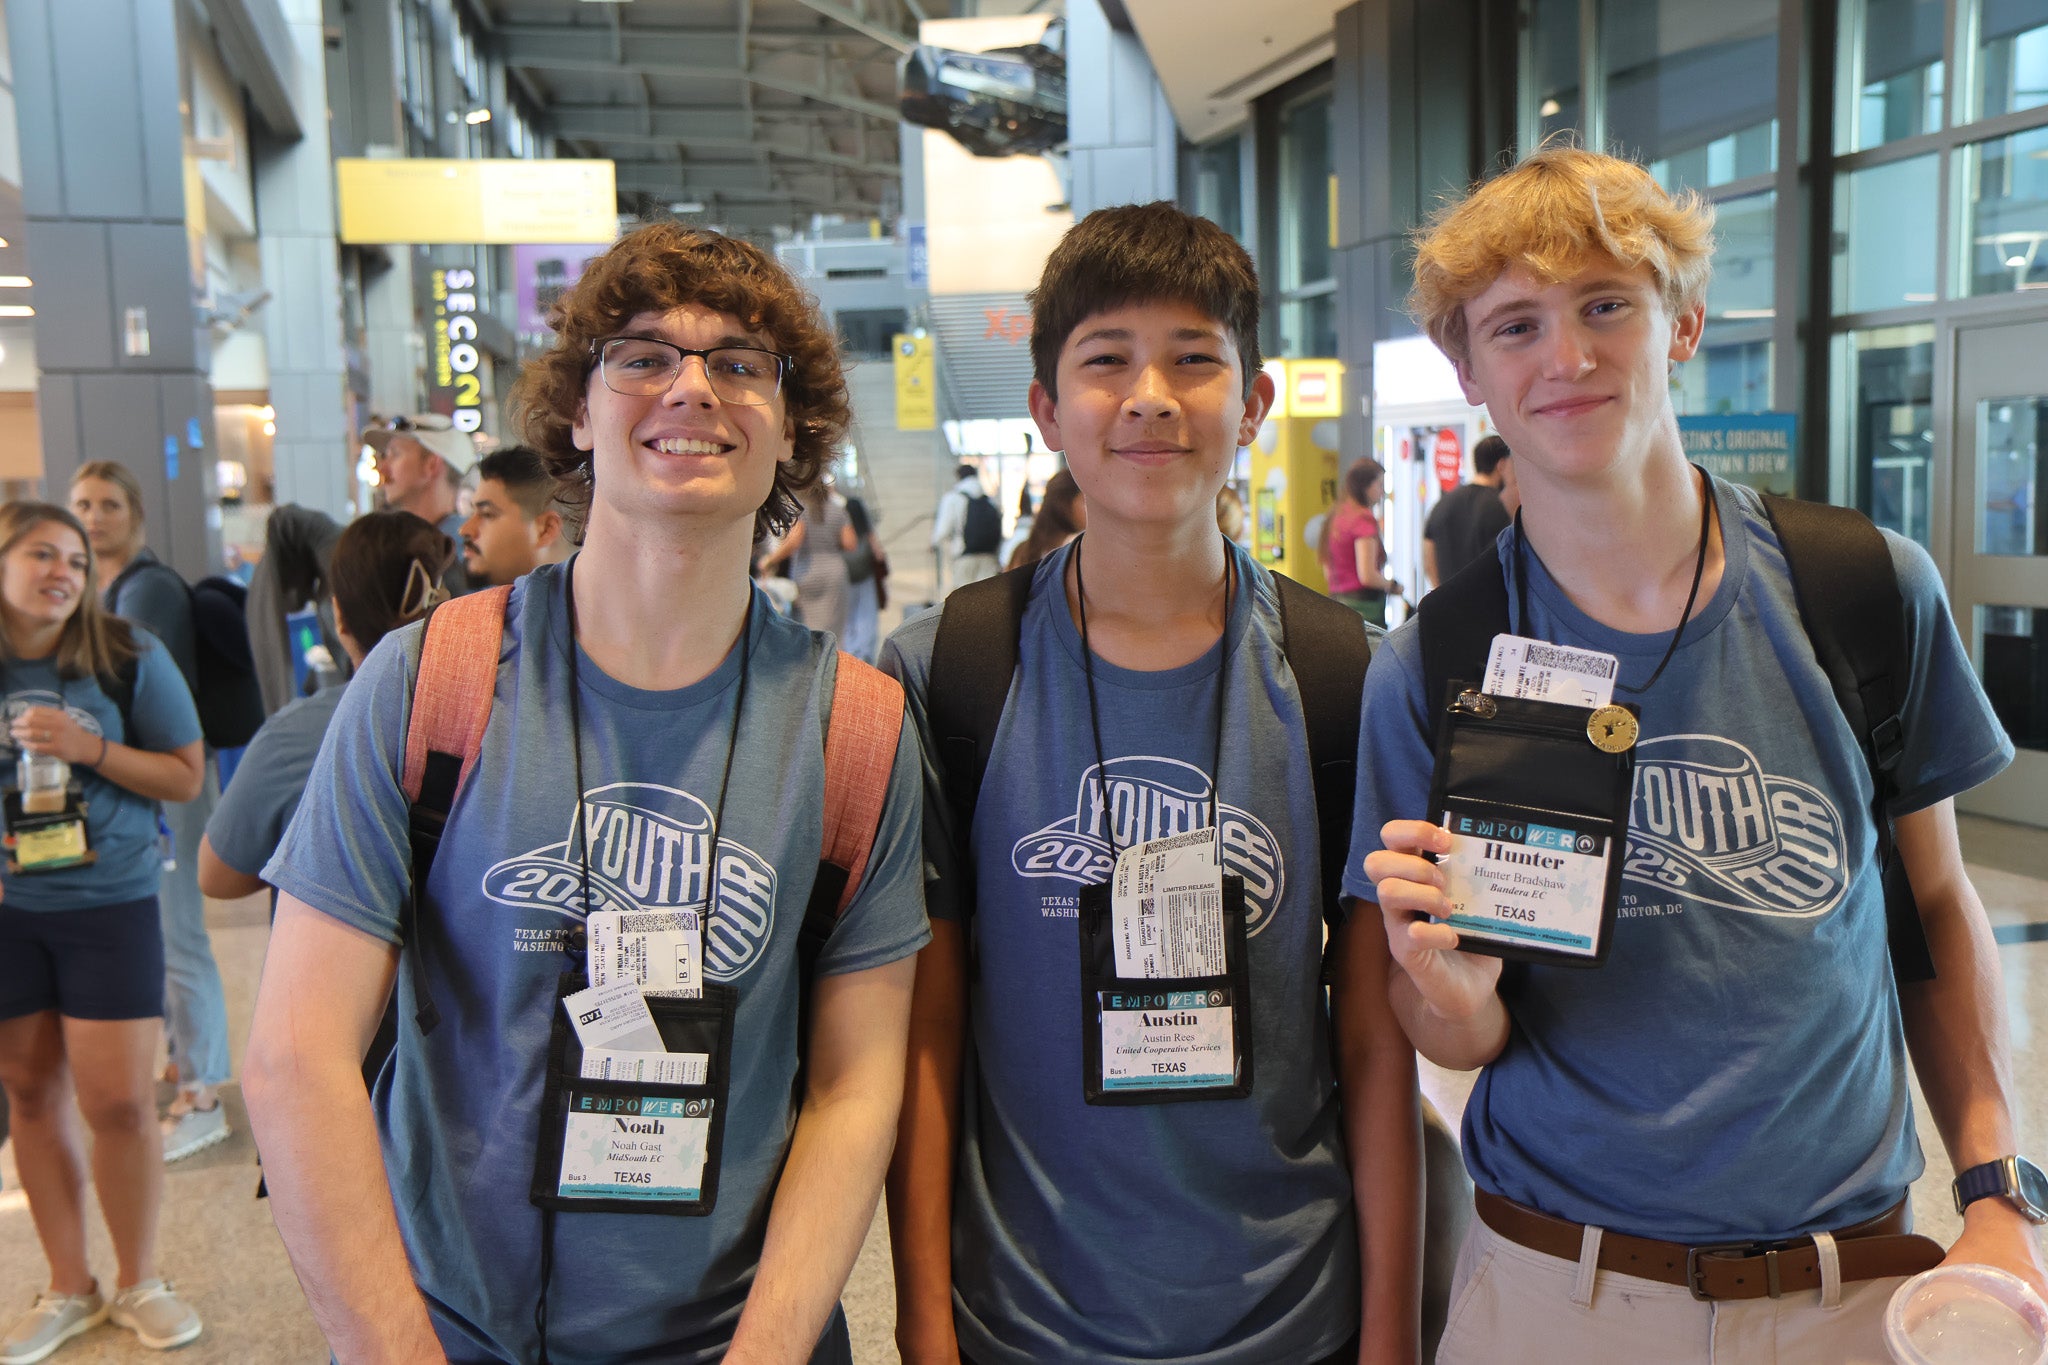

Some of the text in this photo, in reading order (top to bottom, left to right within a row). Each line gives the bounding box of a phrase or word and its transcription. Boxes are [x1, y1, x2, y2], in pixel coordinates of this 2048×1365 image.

[1726, 429, 1787, 451] ORIGINAL
[1747, 453, 1789, 474] BREW
[1460, 818, 1574, 848] EMPOWER
[581, 803, 710, 904] YOUTH
[1483, 842, 1565, 870] Hunter
[1731, 791, 1835, 908] TOUR
[1026, 840, 1117, 883] 202
[1624, 838, 1692, 886] 25
[1223, 820, 1275, 925] UR
[1474, 866, 1566, 890] Hunter Bradshaw
[1162, 883, 1215, 893] LIMITED RELEASE
[1489, 883, 1548, 900] Bandera EC
[1041, 896, 1074, 906] TEXAS
[1622, 895, 1637, 905] TO
[1041, 907, 1080, 919] WASHIN
[1494, 904, 1536, 922] TEXAS
[514, 929, 552, 940] TEXAS
[1112, 994, 1206, 1008] EMPOWER
[581, 1009, 602, 1024] IAD
[1139, 1012, 1198, 1027] Austin
[1142, 1033, 1195, 1043] Austin Rees
[1116, 1044, 1221, 1055] United Cooperative Services
[1151, 1062, 1186, 1073] TEXAS
[581, 1097, 684, 1114] EMPOWER
[612, 1117, 665, 1135] Noah
[611, 1140, 662, 1152] Noah Gast
[606, 1152, 665, 1163] MidSouth EC
[614, 1171, 651, 1184] TEXAS
